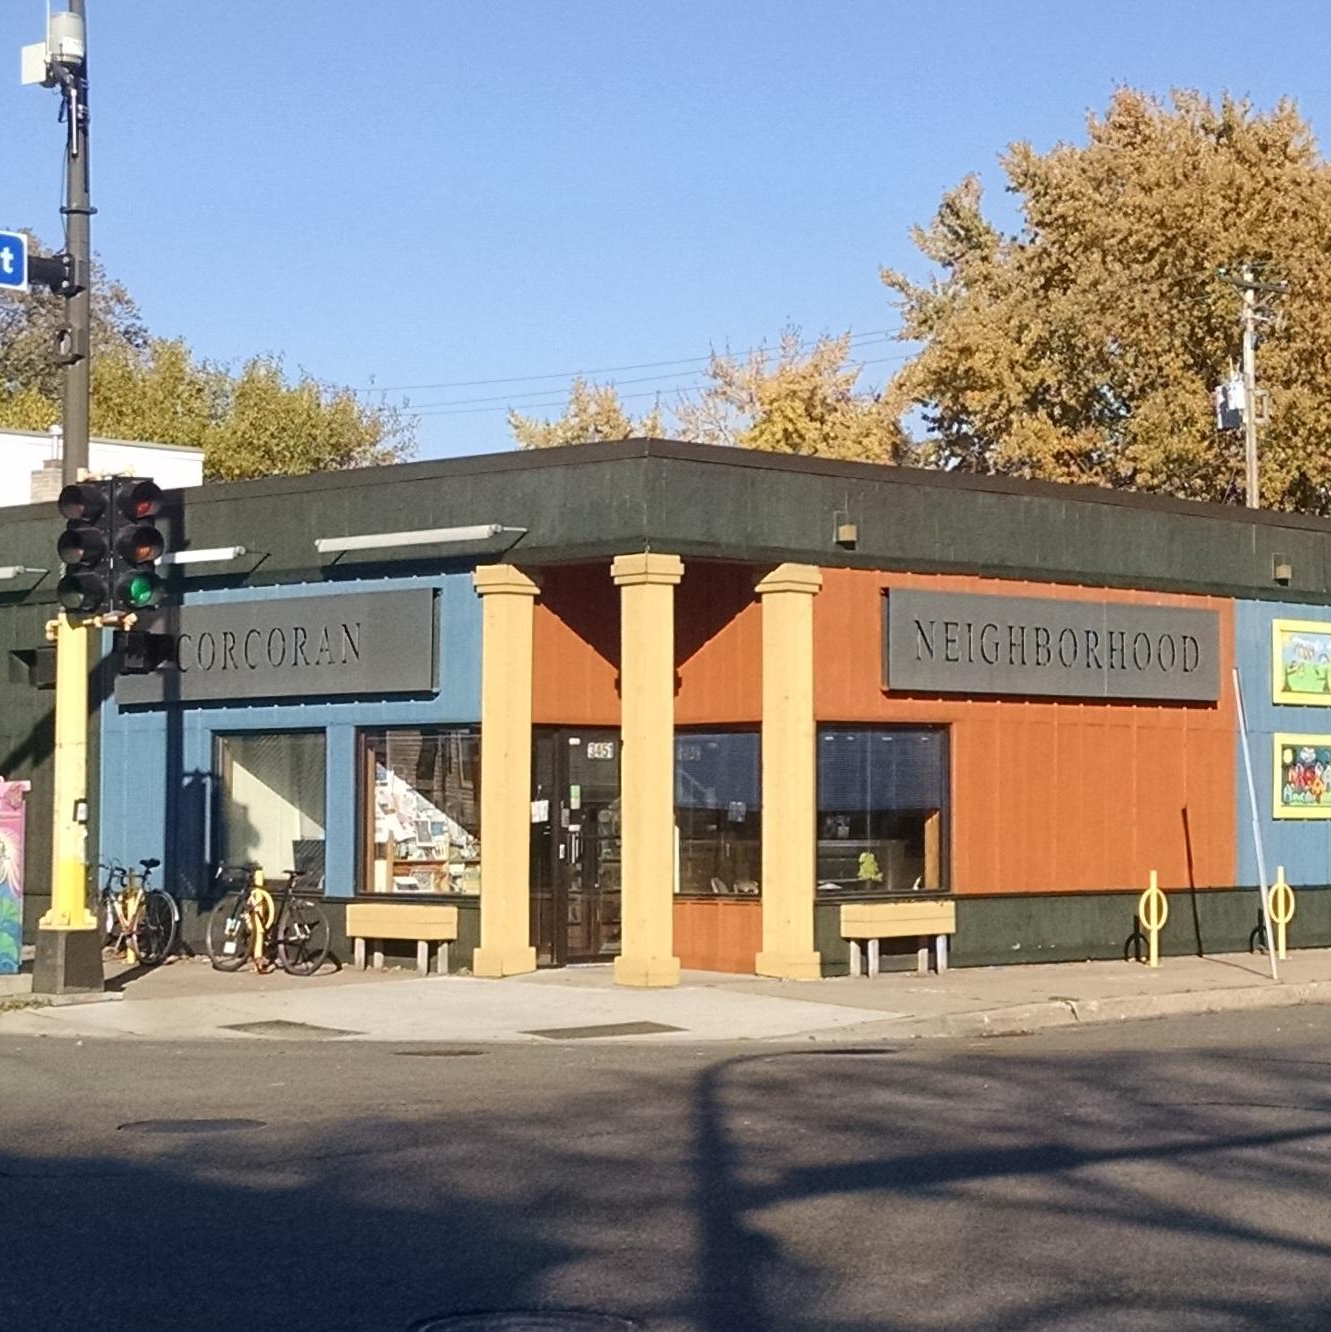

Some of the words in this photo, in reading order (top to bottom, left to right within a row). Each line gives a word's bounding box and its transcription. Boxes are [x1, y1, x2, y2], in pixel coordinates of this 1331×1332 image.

[175, 622, 361, 673] CORCORAN
[913, 619, 1200, 673] NEIGHBORHOOD
[587, 742, 614, 759] 3451
